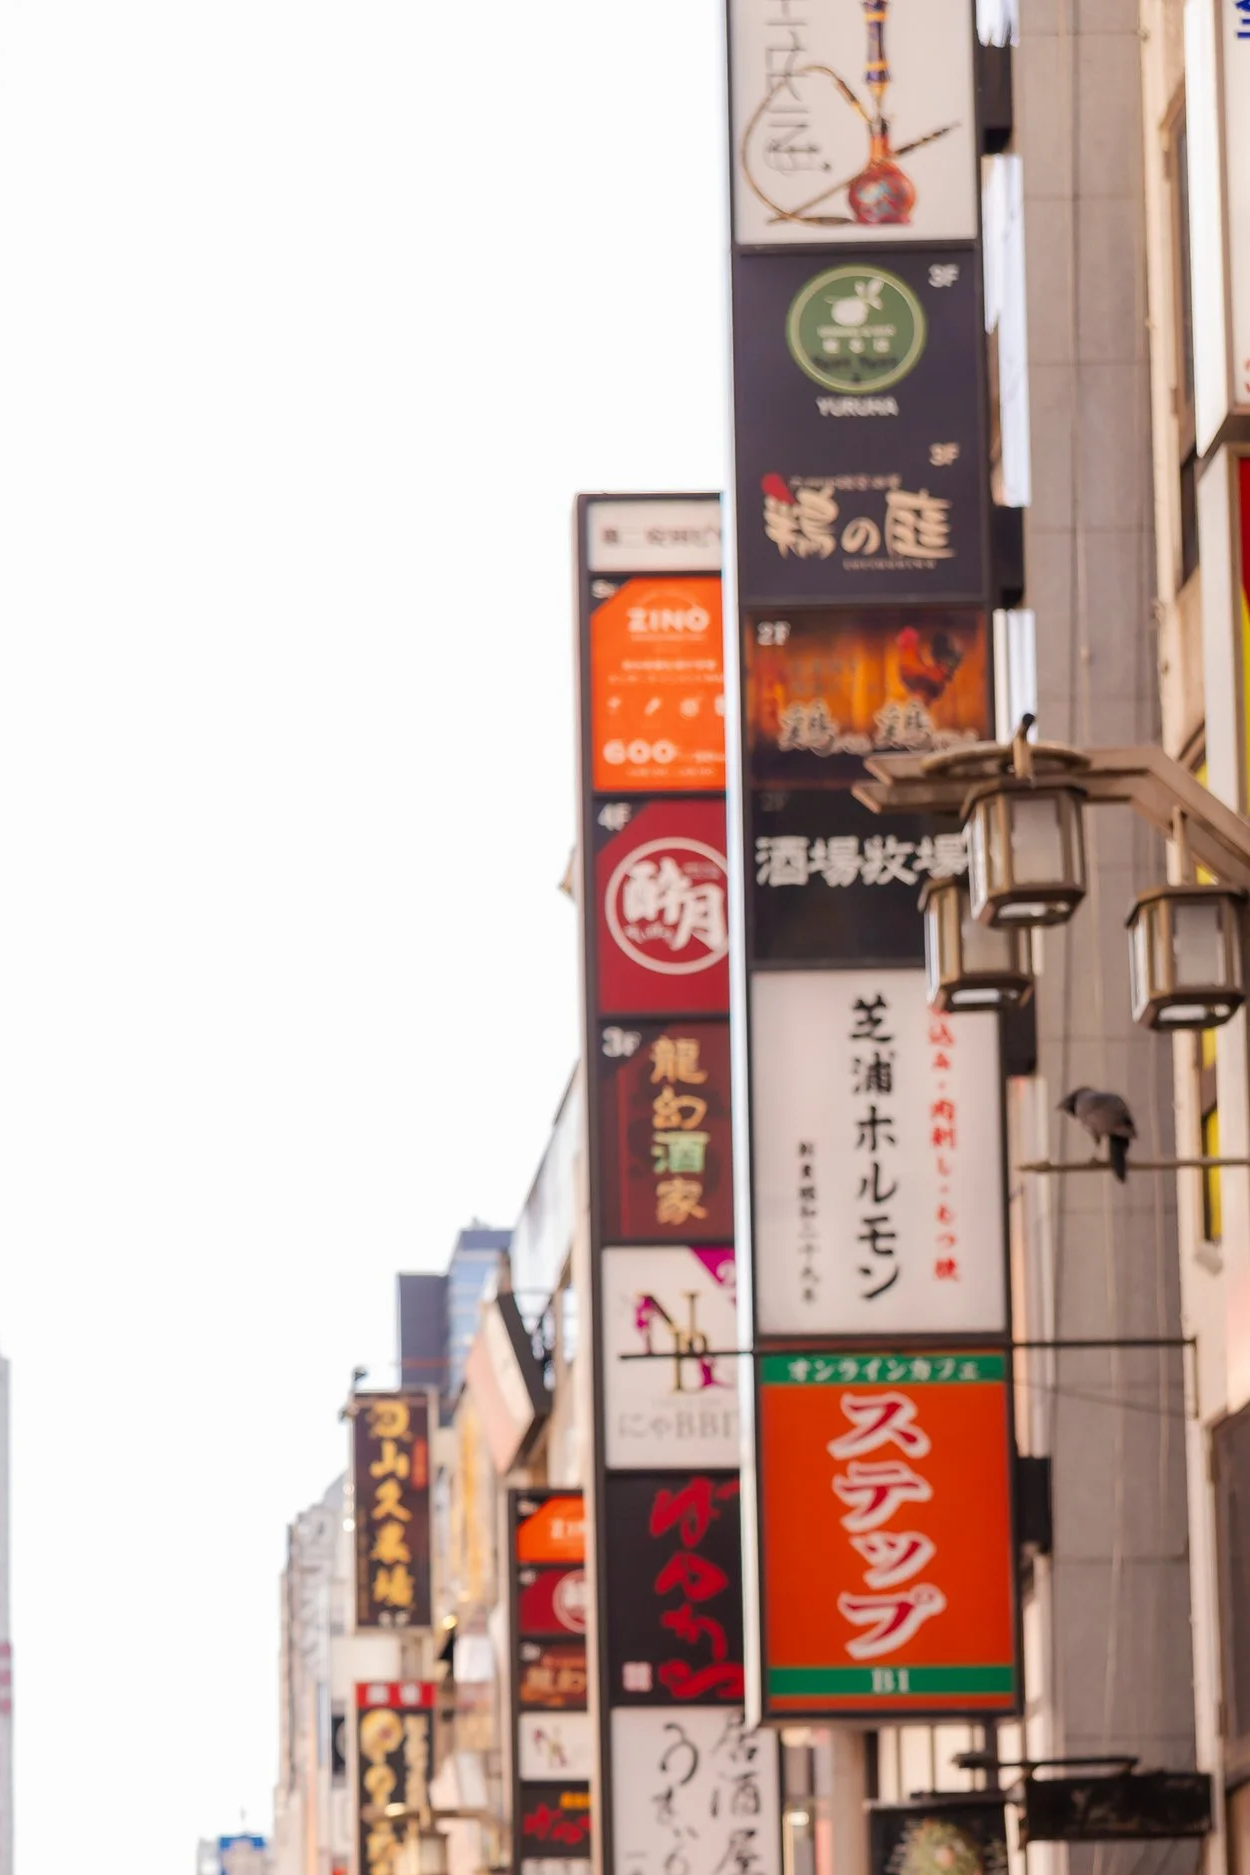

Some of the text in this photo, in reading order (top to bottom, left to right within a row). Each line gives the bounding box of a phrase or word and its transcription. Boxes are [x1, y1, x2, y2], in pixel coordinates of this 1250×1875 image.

[755, 834, 969, 886] 酒場牧場
[849, 993, 900, 1300] 芝浦ホルモン
[787, 1357, 979, 1382] オンラインカフェ
[826, 1391, 947, 1661] ステップ
